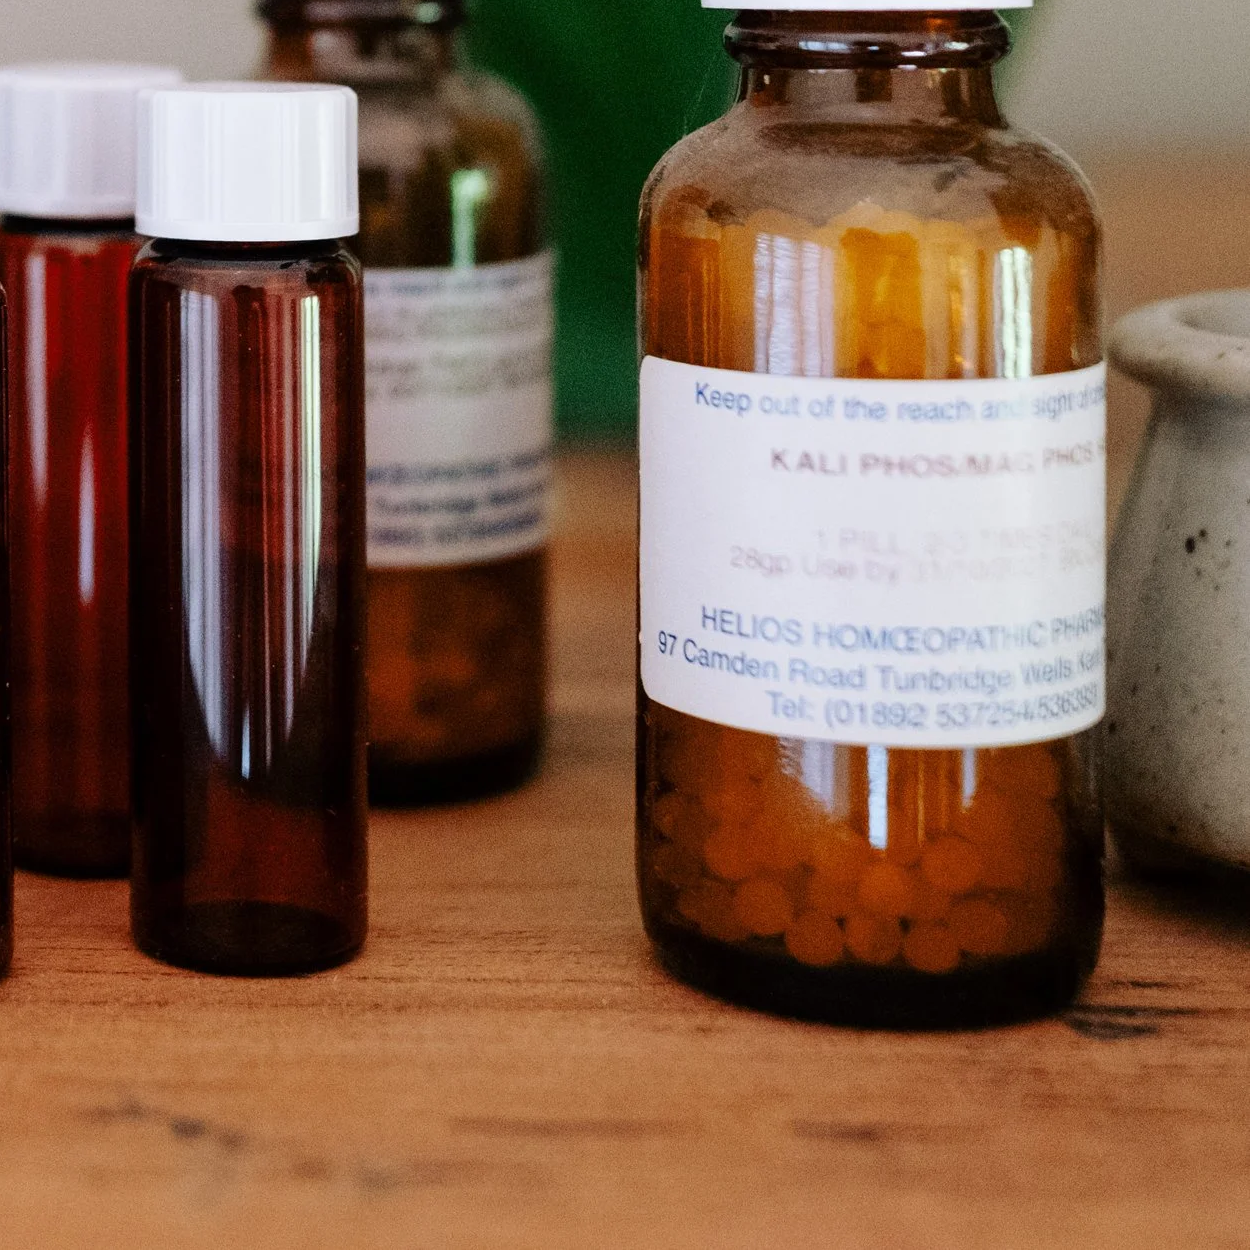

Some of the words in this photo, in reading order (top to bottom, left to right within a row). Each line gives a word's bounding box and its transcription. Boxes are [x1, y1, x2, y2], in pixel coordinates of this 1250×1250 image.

[695, 381, 751, 418] Keep
[759, 394, 799, 416] out
[808, 393, 834, 418] of
[843, 395, 888, 421] the
[897, 395, 974, 422] reach
[981, 393, 1025, 421] and
[1031, 388, 1073, 422] sight
[770, 448, 849, 478] KALI
[701, 605, 803, 646] HELIOS
[657, 629, 677, 657] 97
[682, 637, 781, 683] Camden
[789, 657, 867, 691] Road
[875, 663, 1013, 699] Tunbridge
[1020, 654, 1073, 686] Wells
[765, 690, 814, 722] Tel:
[824, 698, 929, 733] (01892
